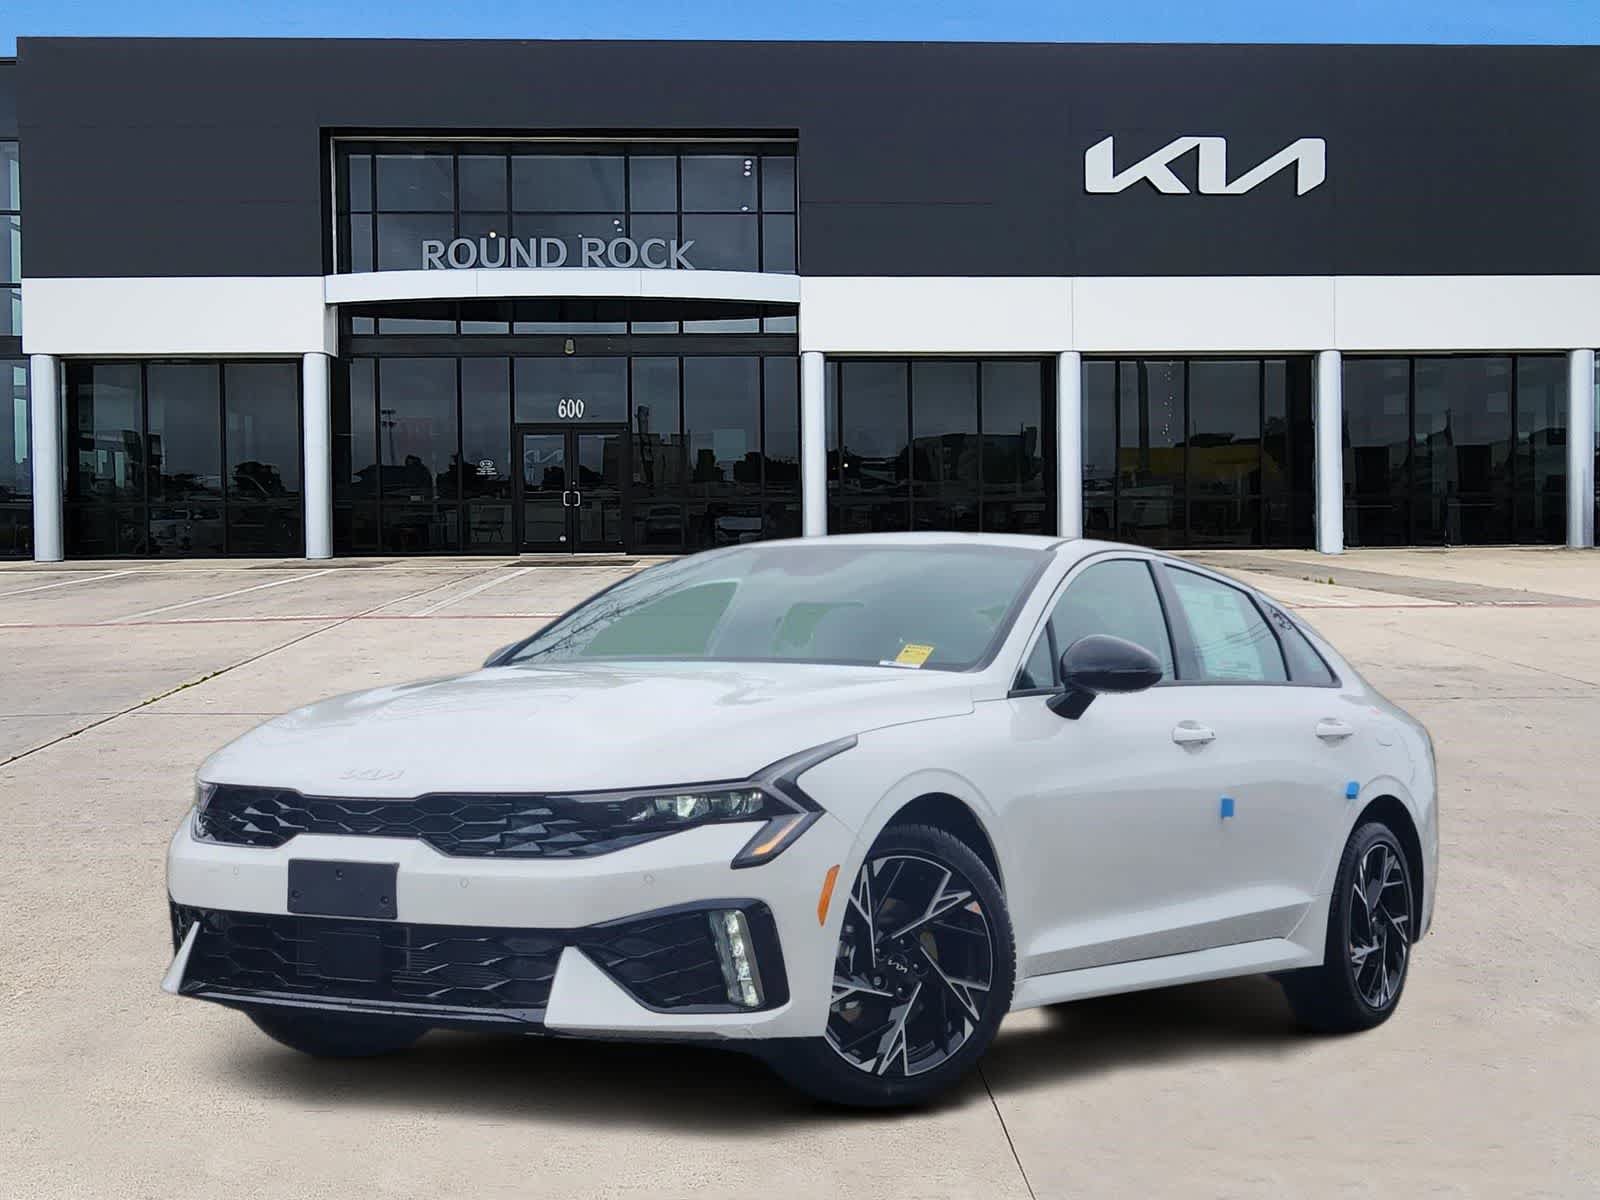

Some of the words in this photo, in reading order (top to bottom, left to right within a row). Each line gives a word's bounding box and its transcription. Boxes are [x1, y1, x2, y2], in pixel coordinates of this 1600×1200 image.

[1085, 135, 1326, 196] KIA
[422, 237, 568, 270] ROUND
[581, 237, 696, 270] ROCK
[558, 399, 584, 418] 600
